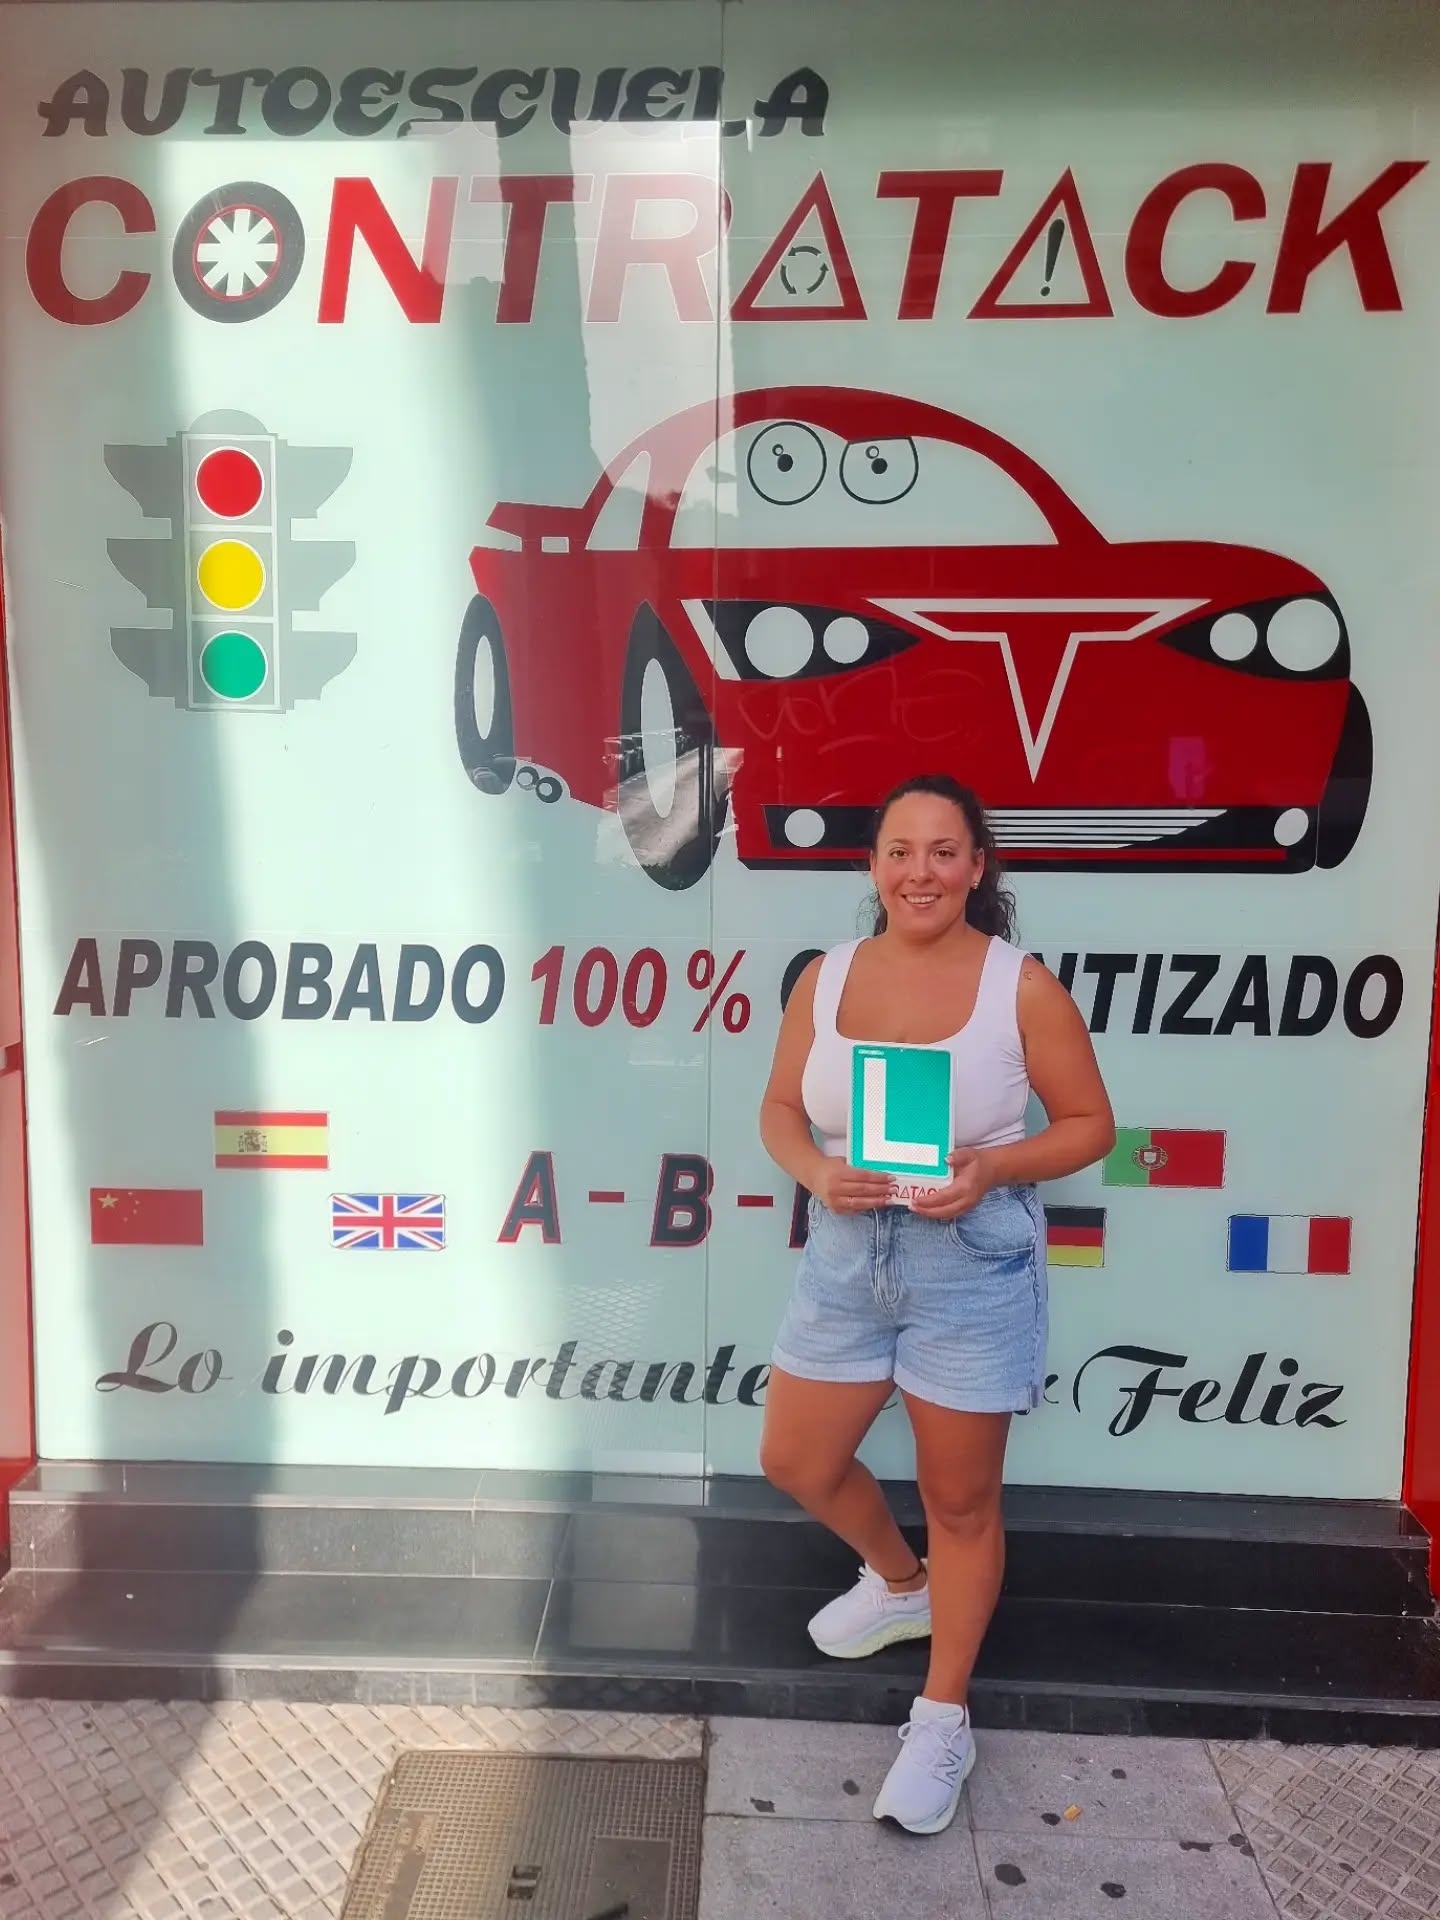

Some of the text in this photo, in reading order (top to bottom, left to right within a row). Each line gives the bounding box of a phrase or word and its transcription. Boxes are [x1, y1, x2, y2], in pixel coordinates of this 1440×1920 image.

[38, 66, 829, 138] AUTOESCUELA
[25, 160, 1429, 326] CONTRATACK
[53, 938, 505, 1023] APROBADO
[530, 946, 667, 1028] 100
[862, 1058, 939, 1167] L
[497, 1151, 562, 1244] A
[650, 1153, 713, 1248] B
[95, 1321, 233, 1395] Lo
[261, 1329, 771, 1415] importante
[1073, 1345, 1347, 1437] Feliz
